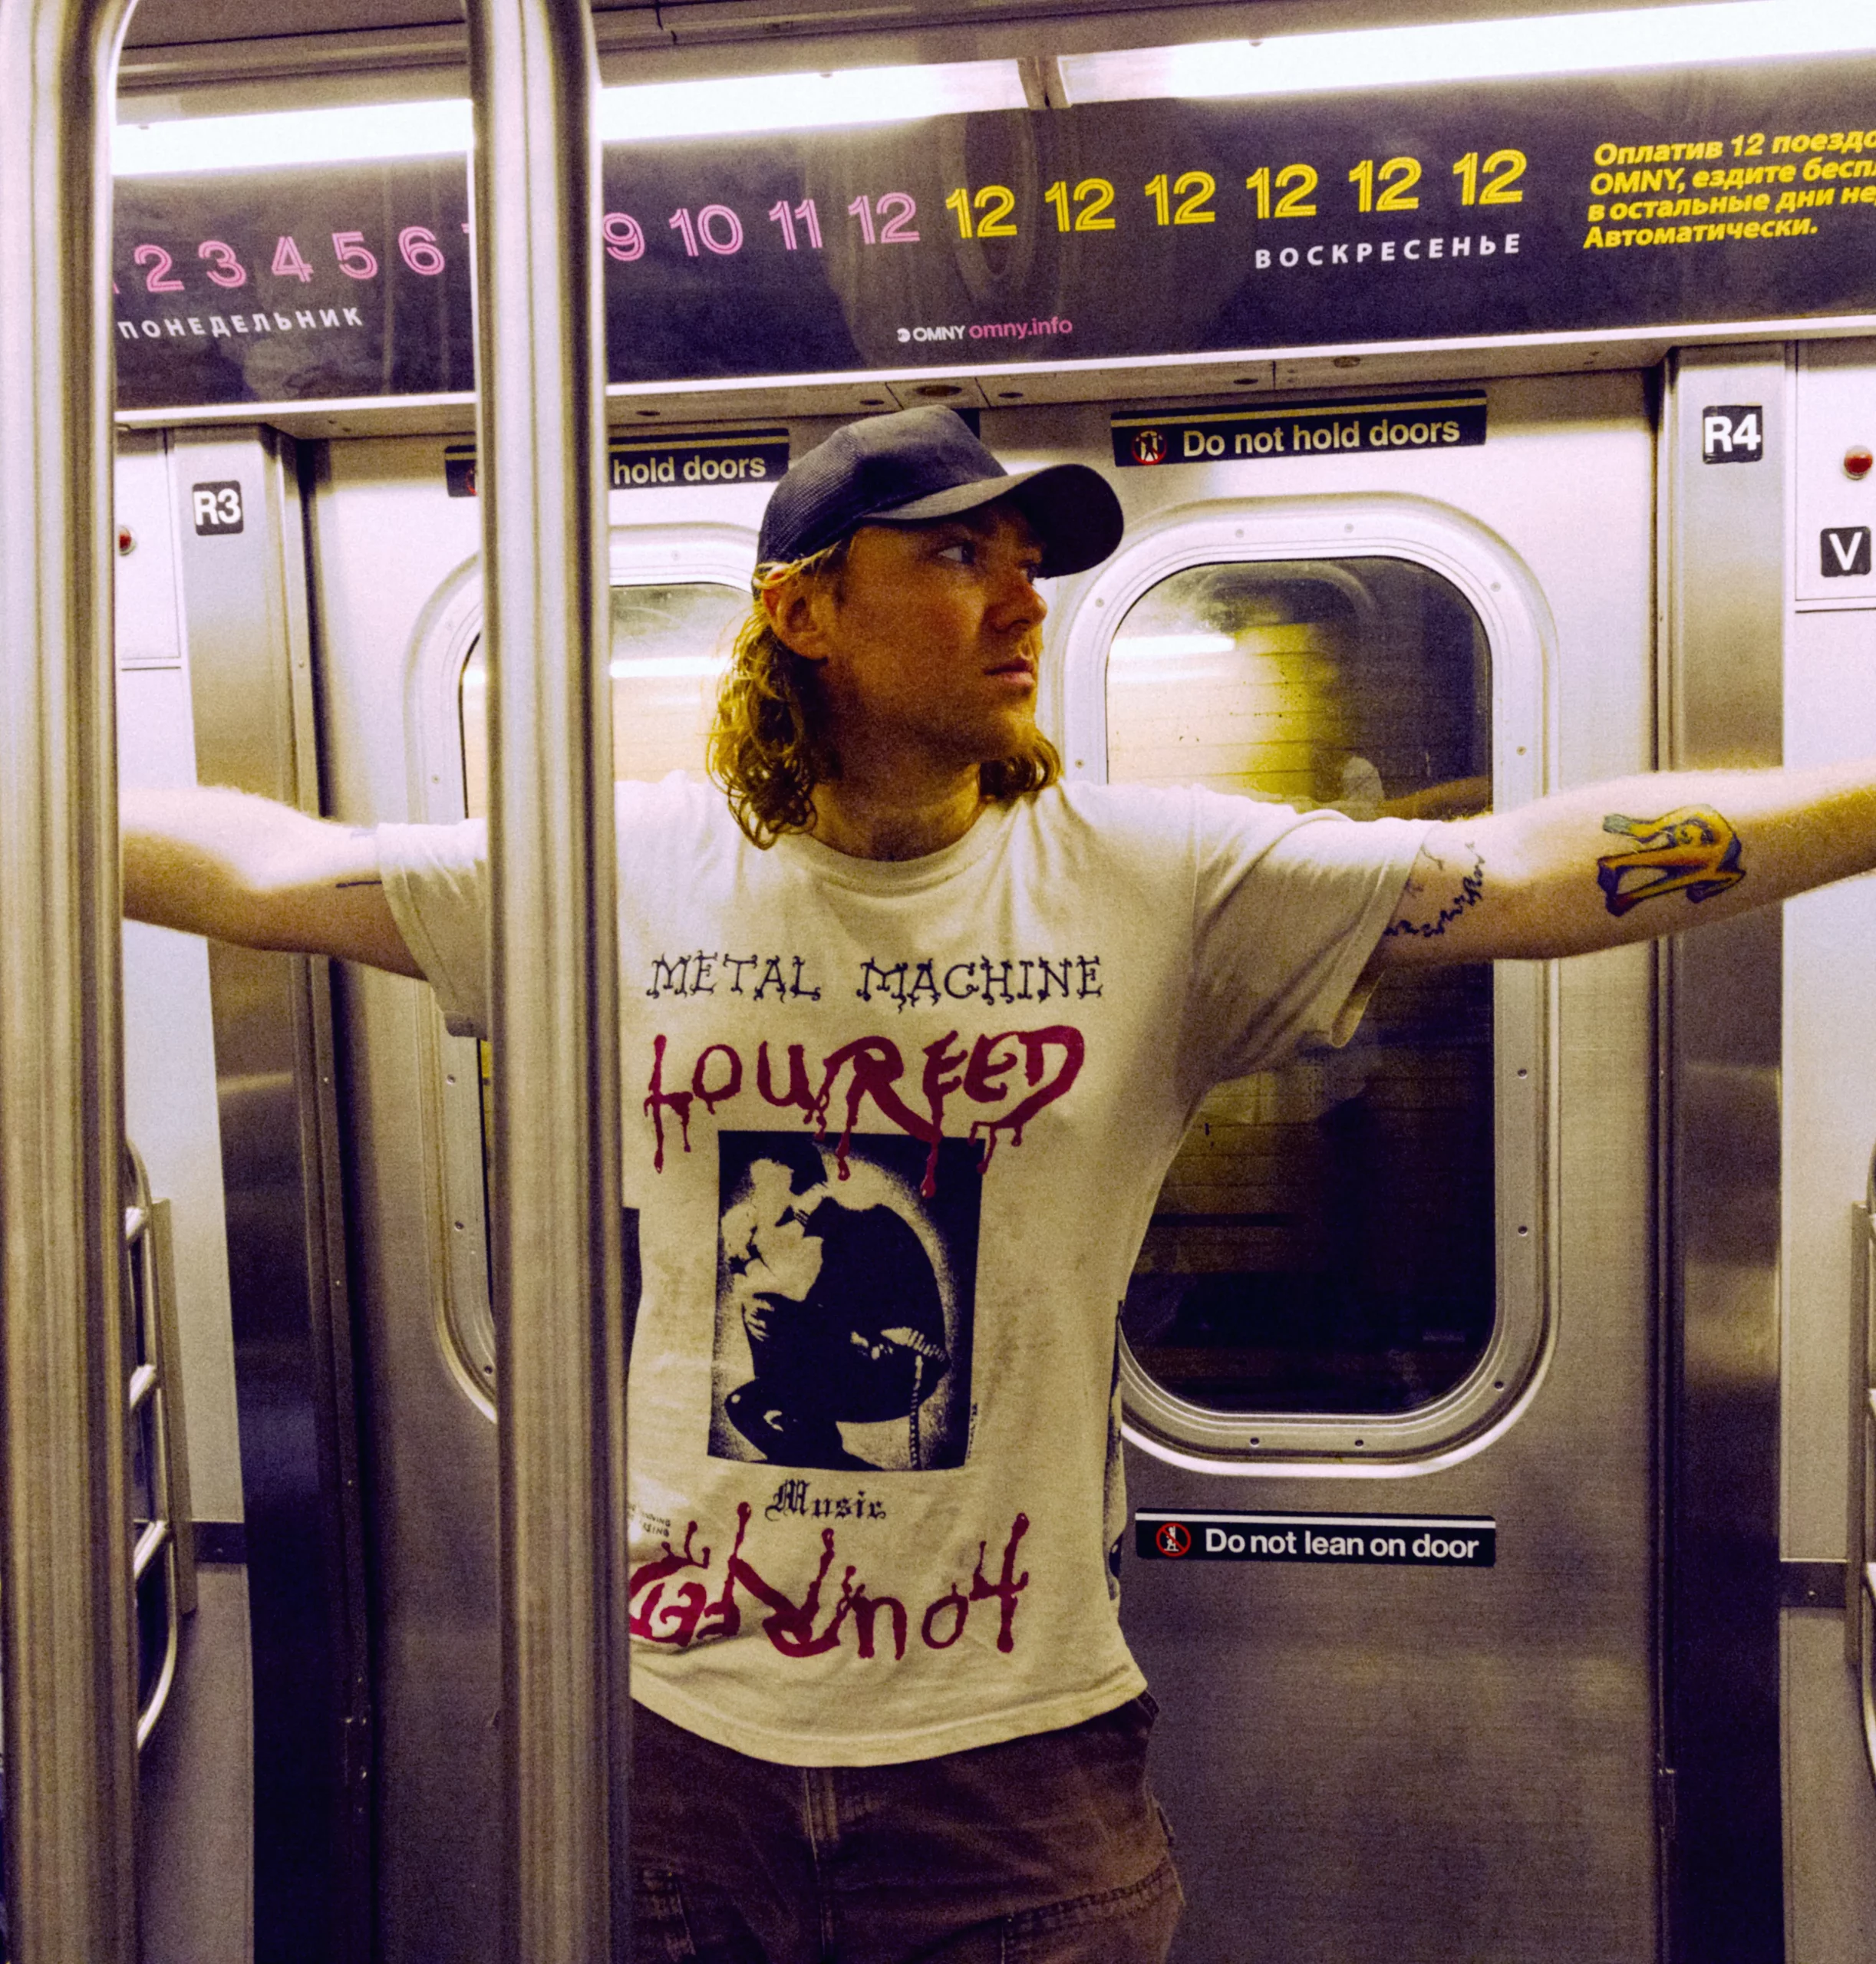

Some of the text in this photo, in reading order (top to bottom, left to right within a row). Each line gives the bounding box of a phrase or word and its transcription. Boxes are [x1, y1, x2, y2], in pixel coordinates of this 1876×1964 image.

[1594, 140, 1723, 166] Оплатив
[1730, 133, 1766, 157] 12
[1692, 164, 1796, 189] ездите
[602, 148, 1528, 262] 9 10 11 12 12 12 12 12 12 12
[1587, 185, 1876, 222] в остальные дни не
[1255, 233, 1521, 269] ВОСКРЕСЕНЬЕ
[1582, 217, 1818, 249] Автоматически.
[134, 226, 445, 292] 2 3 4 5 6
[117, 307, 363, 339] ПОНЕДЕЛЬНИК
[912, 316, 1073, 341] OMNY omny.info
[1182, 419, 1460, 457] Do not hold doors
[1704, 414, 1761, 453] R4
[614, 456, 767, 485] hold doors
[193, 489, 241, 526] R3
[1828, 532, 1863, 571] V
[646, 950, 1103, 1013] METAL MACHINE
[764, 1479, 886, 1521] Music
[1205, 1528, 1479, 1559] Do not lean on door
